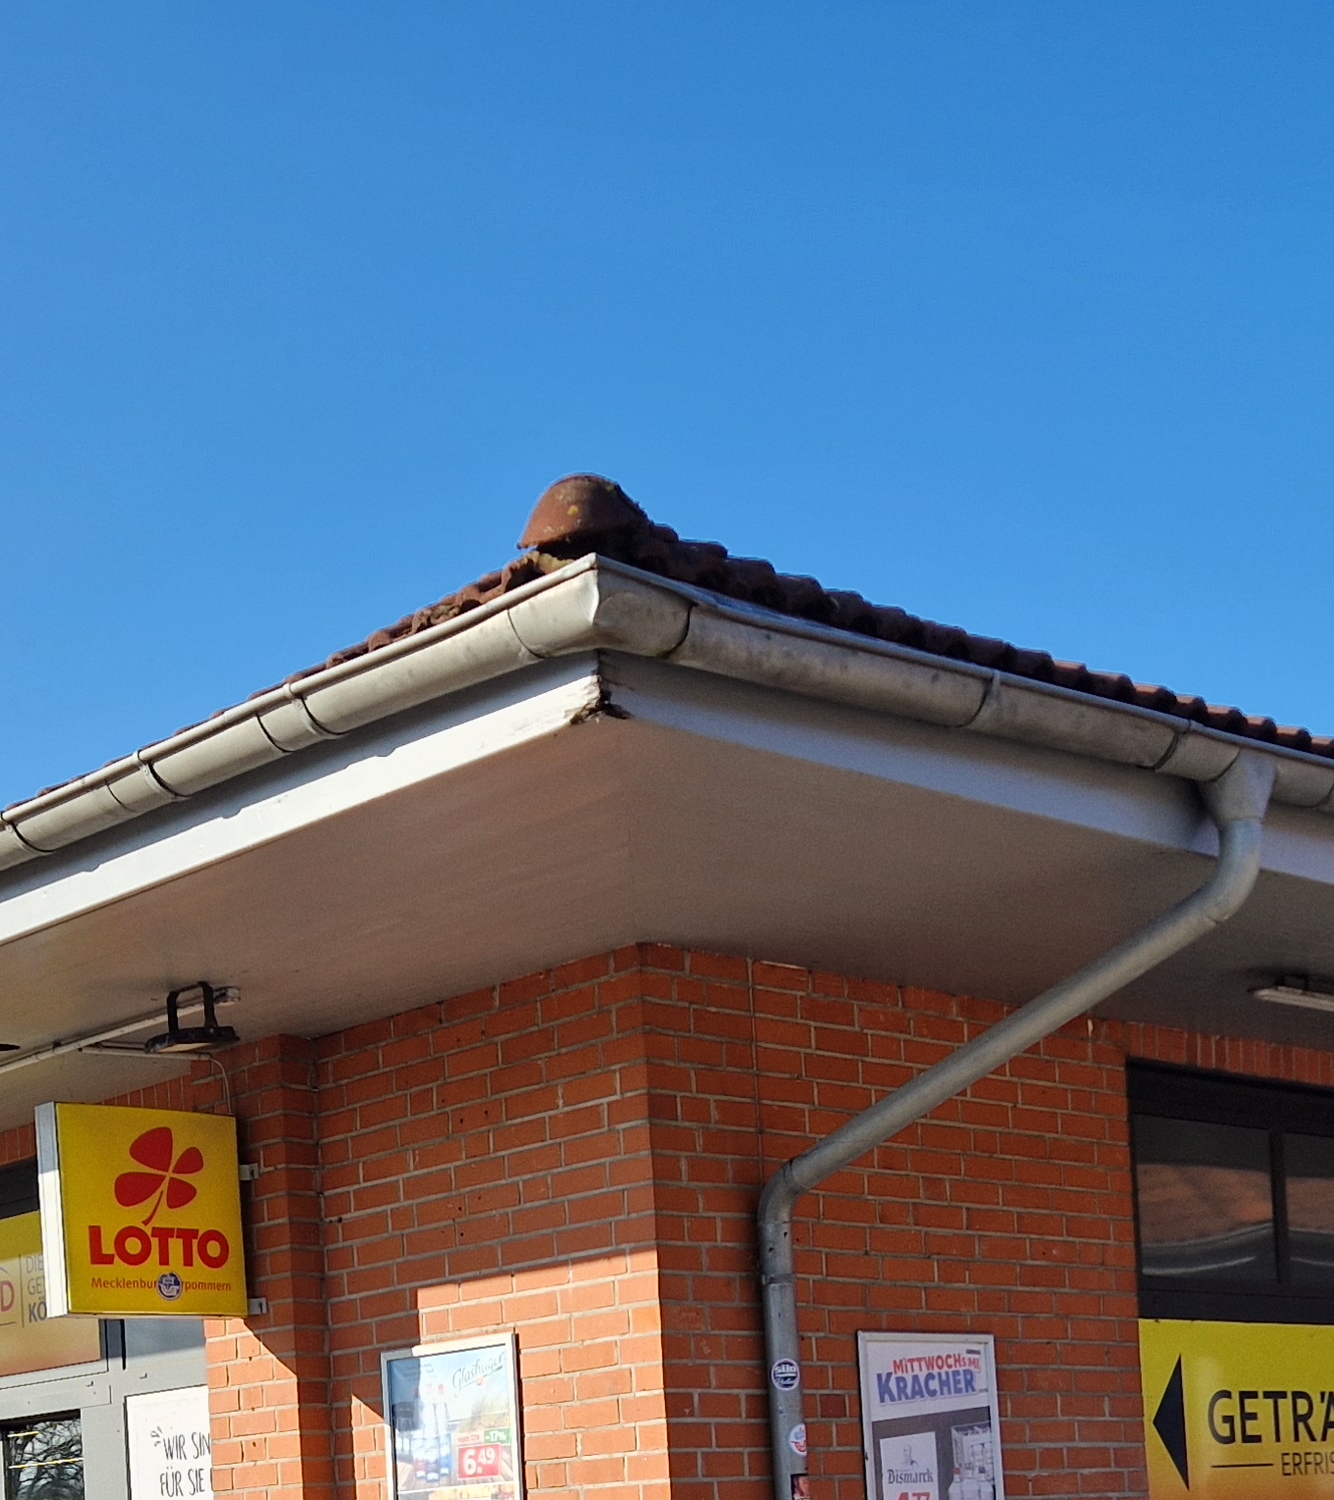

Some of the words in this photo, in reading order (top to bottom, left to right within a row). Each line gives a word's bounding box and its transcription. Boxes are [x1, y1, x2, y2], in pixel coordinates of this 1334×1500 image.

[88, 1225, 229, 1269] LOTTO
[876, 1368, 976, 1404] KRACHER
[163, 1434, 187, 1460] WIR
[160, 1465, 184, 1497] FÜR
[188, 1468, 205, 1496] SIE
[888, 1468, 934, 1485] Bismarck
